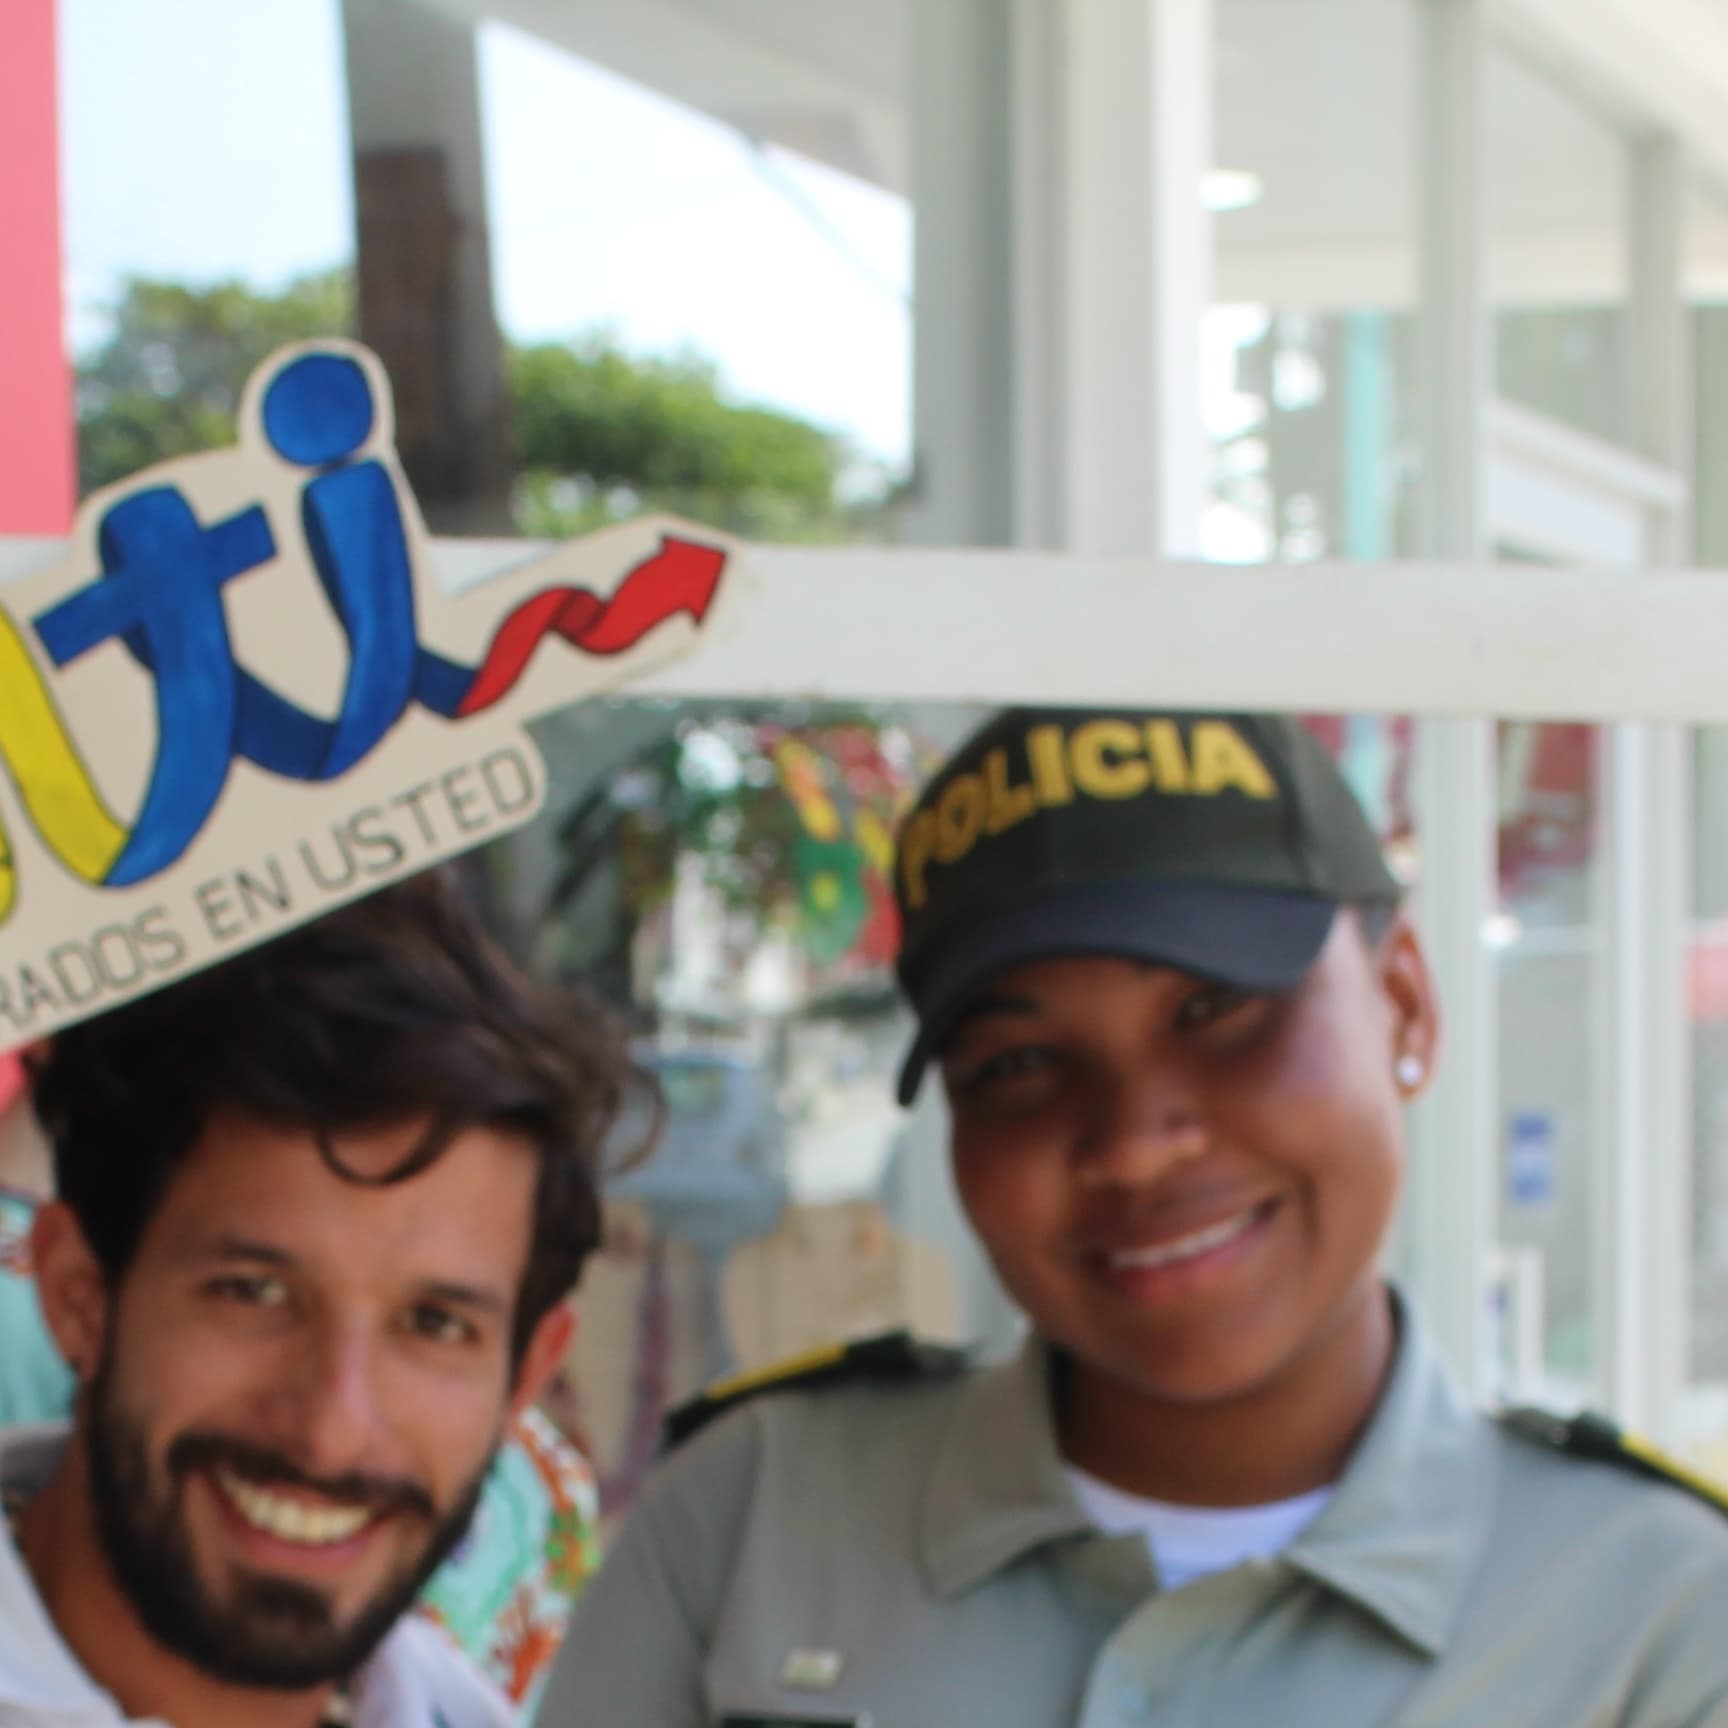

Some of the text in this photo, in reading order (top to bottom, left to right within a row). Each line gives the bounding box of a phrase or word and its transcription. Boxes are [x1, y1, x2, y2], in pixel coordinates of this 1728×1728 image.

[195, 858, 291, 942] EN
[302, 746, 538, 894] USTED
[903, 718, 1279, 908] POLICIA
